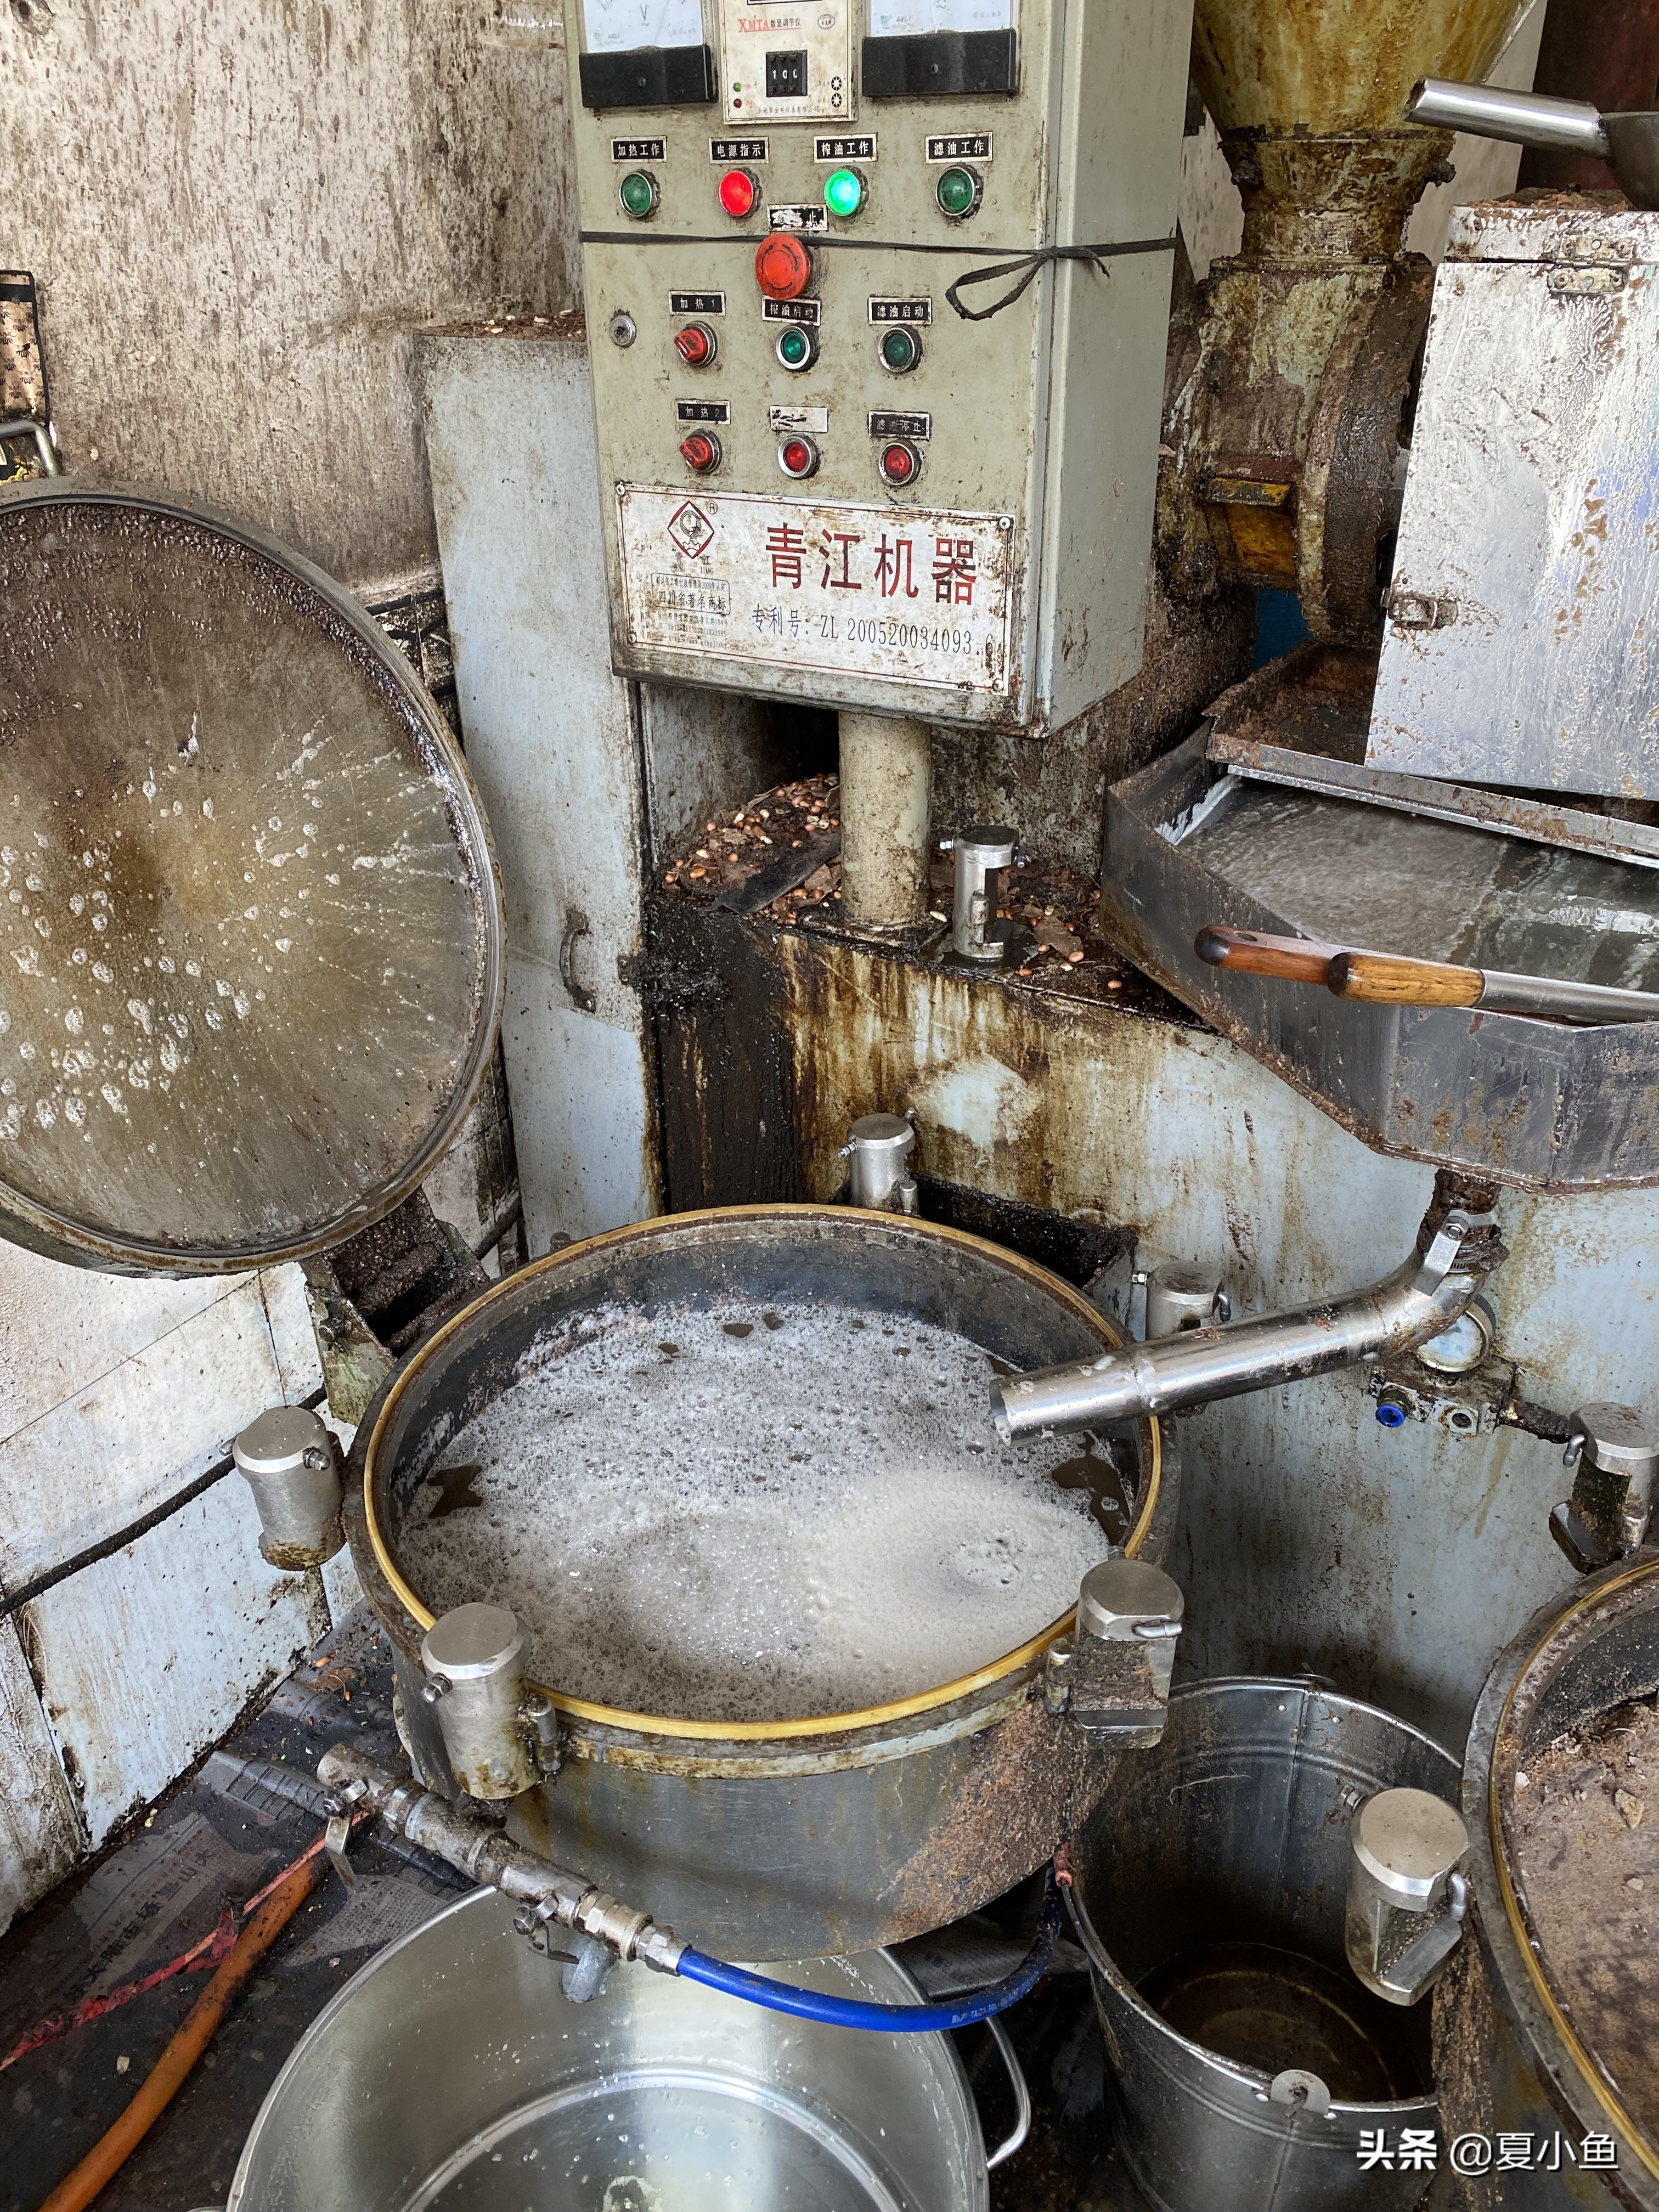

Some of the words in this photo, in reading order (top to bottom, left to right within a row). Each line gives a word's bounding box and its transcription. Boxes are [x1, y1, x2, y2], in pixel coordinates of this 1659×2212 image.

[737, 18, 770, 33] XMTA
[770, 17, 802, 28] 数显调节仪
[617, 143, 659, 157] 加热工作
[716, 144, 761, 157] 电源指示
[821, 140, 869, 156] 榨油工作
[934, 139, 985, 156] 滤油工作
[769, 302, 814, 318] 榨油启动
[877, 304, 924, 318] 滤油启动
[765, 522, 978, 606] 青江机器
[659, 590, 726, 611] 四川省著名商标
[821, 615, 839, 639] ZL
